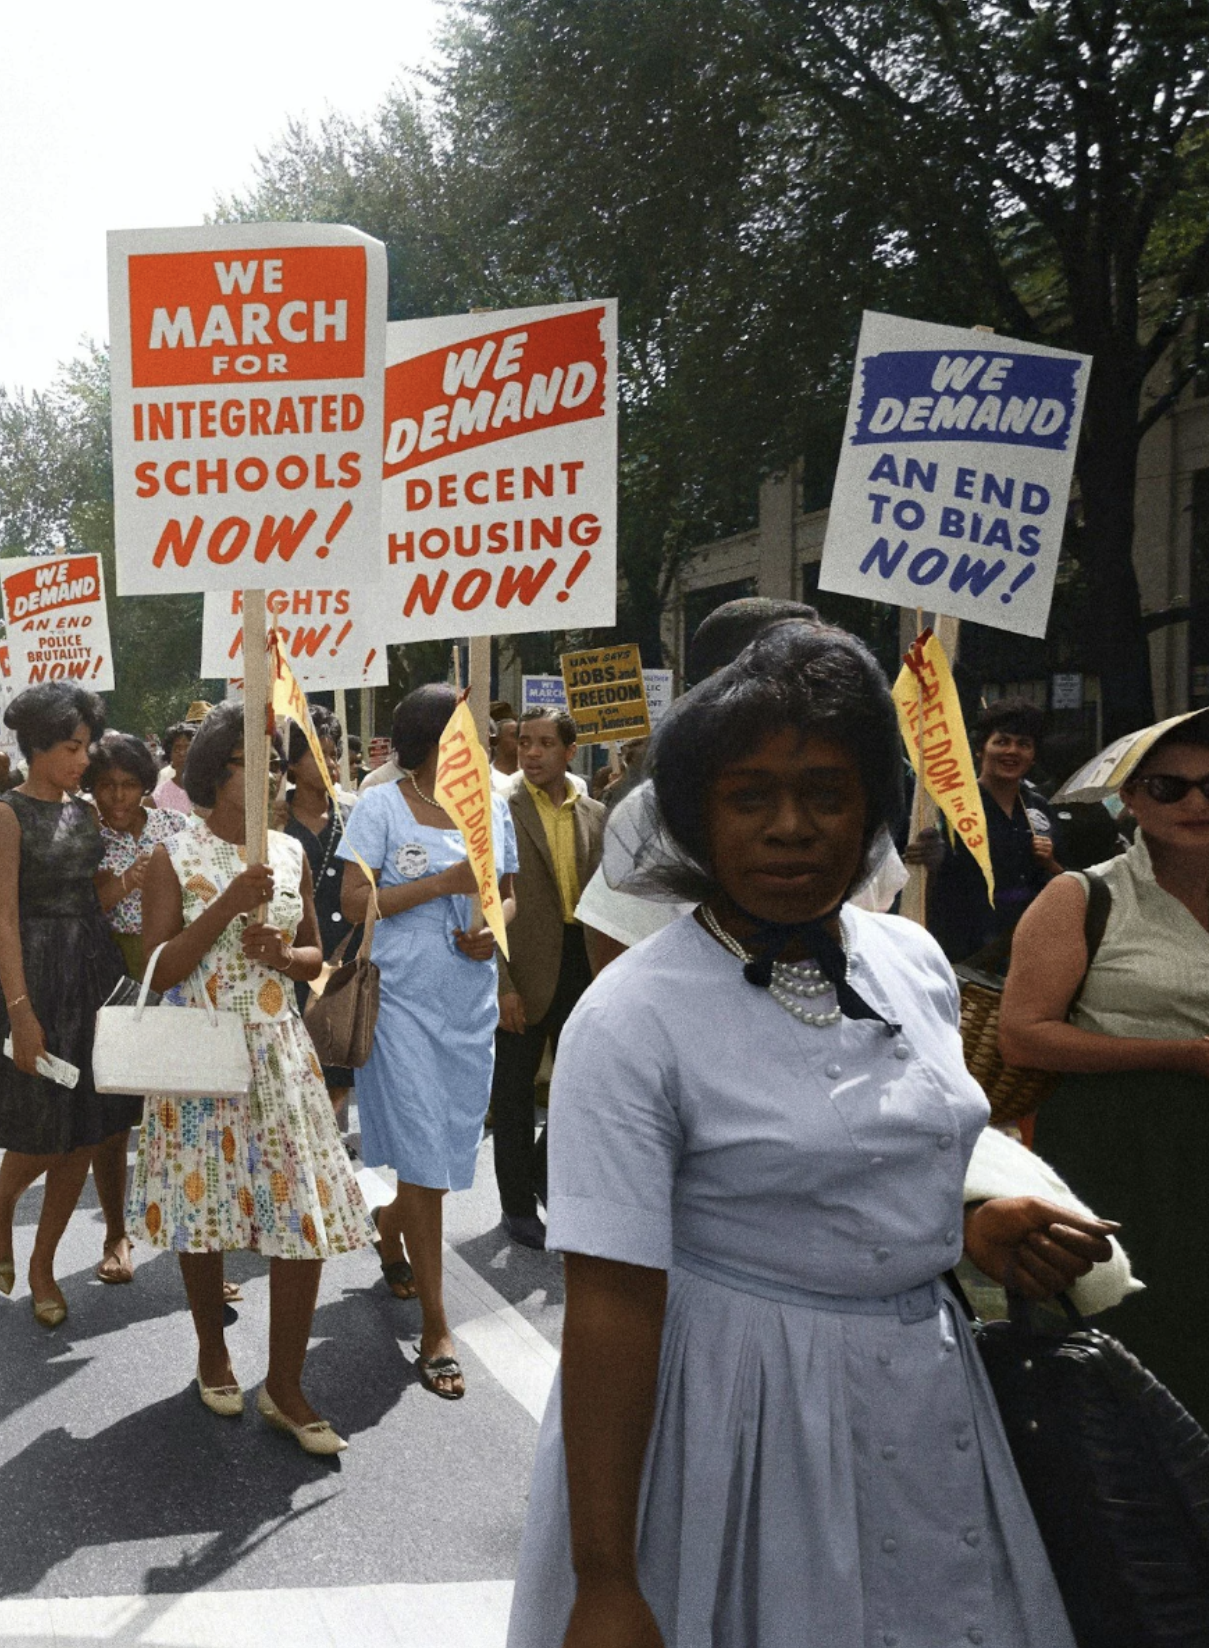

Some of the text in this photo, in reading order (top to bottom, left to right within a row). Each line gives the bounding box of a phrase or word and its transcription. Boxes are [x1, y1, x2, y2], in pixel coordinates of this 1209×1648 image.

[214, 259, 283, 295] WE
[149, 300, 347, 349] MARCH
[213, 354, 288, 375] FOR
[442, 332, 528, 395] WE
[931, 355, 1013, 392] WE
[133, 394, 364, 441] INTEGRATED
[384, 361, 597, 464] DEMAND
[868, 395, 1066, 435] DEMAND
[135, 452, 361, 498] SCHOOLS
[406, 461, 585, 511] DECENT
[868, 453, 1050, 515] AN END
[152, 501, 353, 568] NOW!
[389, 514, 602, 564] HOUSING
[868, 493, 1041, 556] TO BIAS
[35, 562, 69, 588] WE
[402, 550, 592, 617] NOW!
[859, 537, 1035, 604] NOW!
[13, 576, 95, 617] DEMAND
[231, 589, 350, 615] RGHTS
[22, 616, 92, 631] AN END
[39, 635, 82, 648] POLICE
[27, 648, 92, 663] BRUTALITY
[28, 655, 103, 684] NOW!
[569, 650, 630, 667] UAW SAYS
[529, 688, 565, 697] MARCH
[569, 666, 637, 688] JOBS and
[571, 684, 641, 708] FREEDOM
[901, 659, 984, 849] FREEDOM IN '63
[437, 730, 489, 861] FREEDOM
